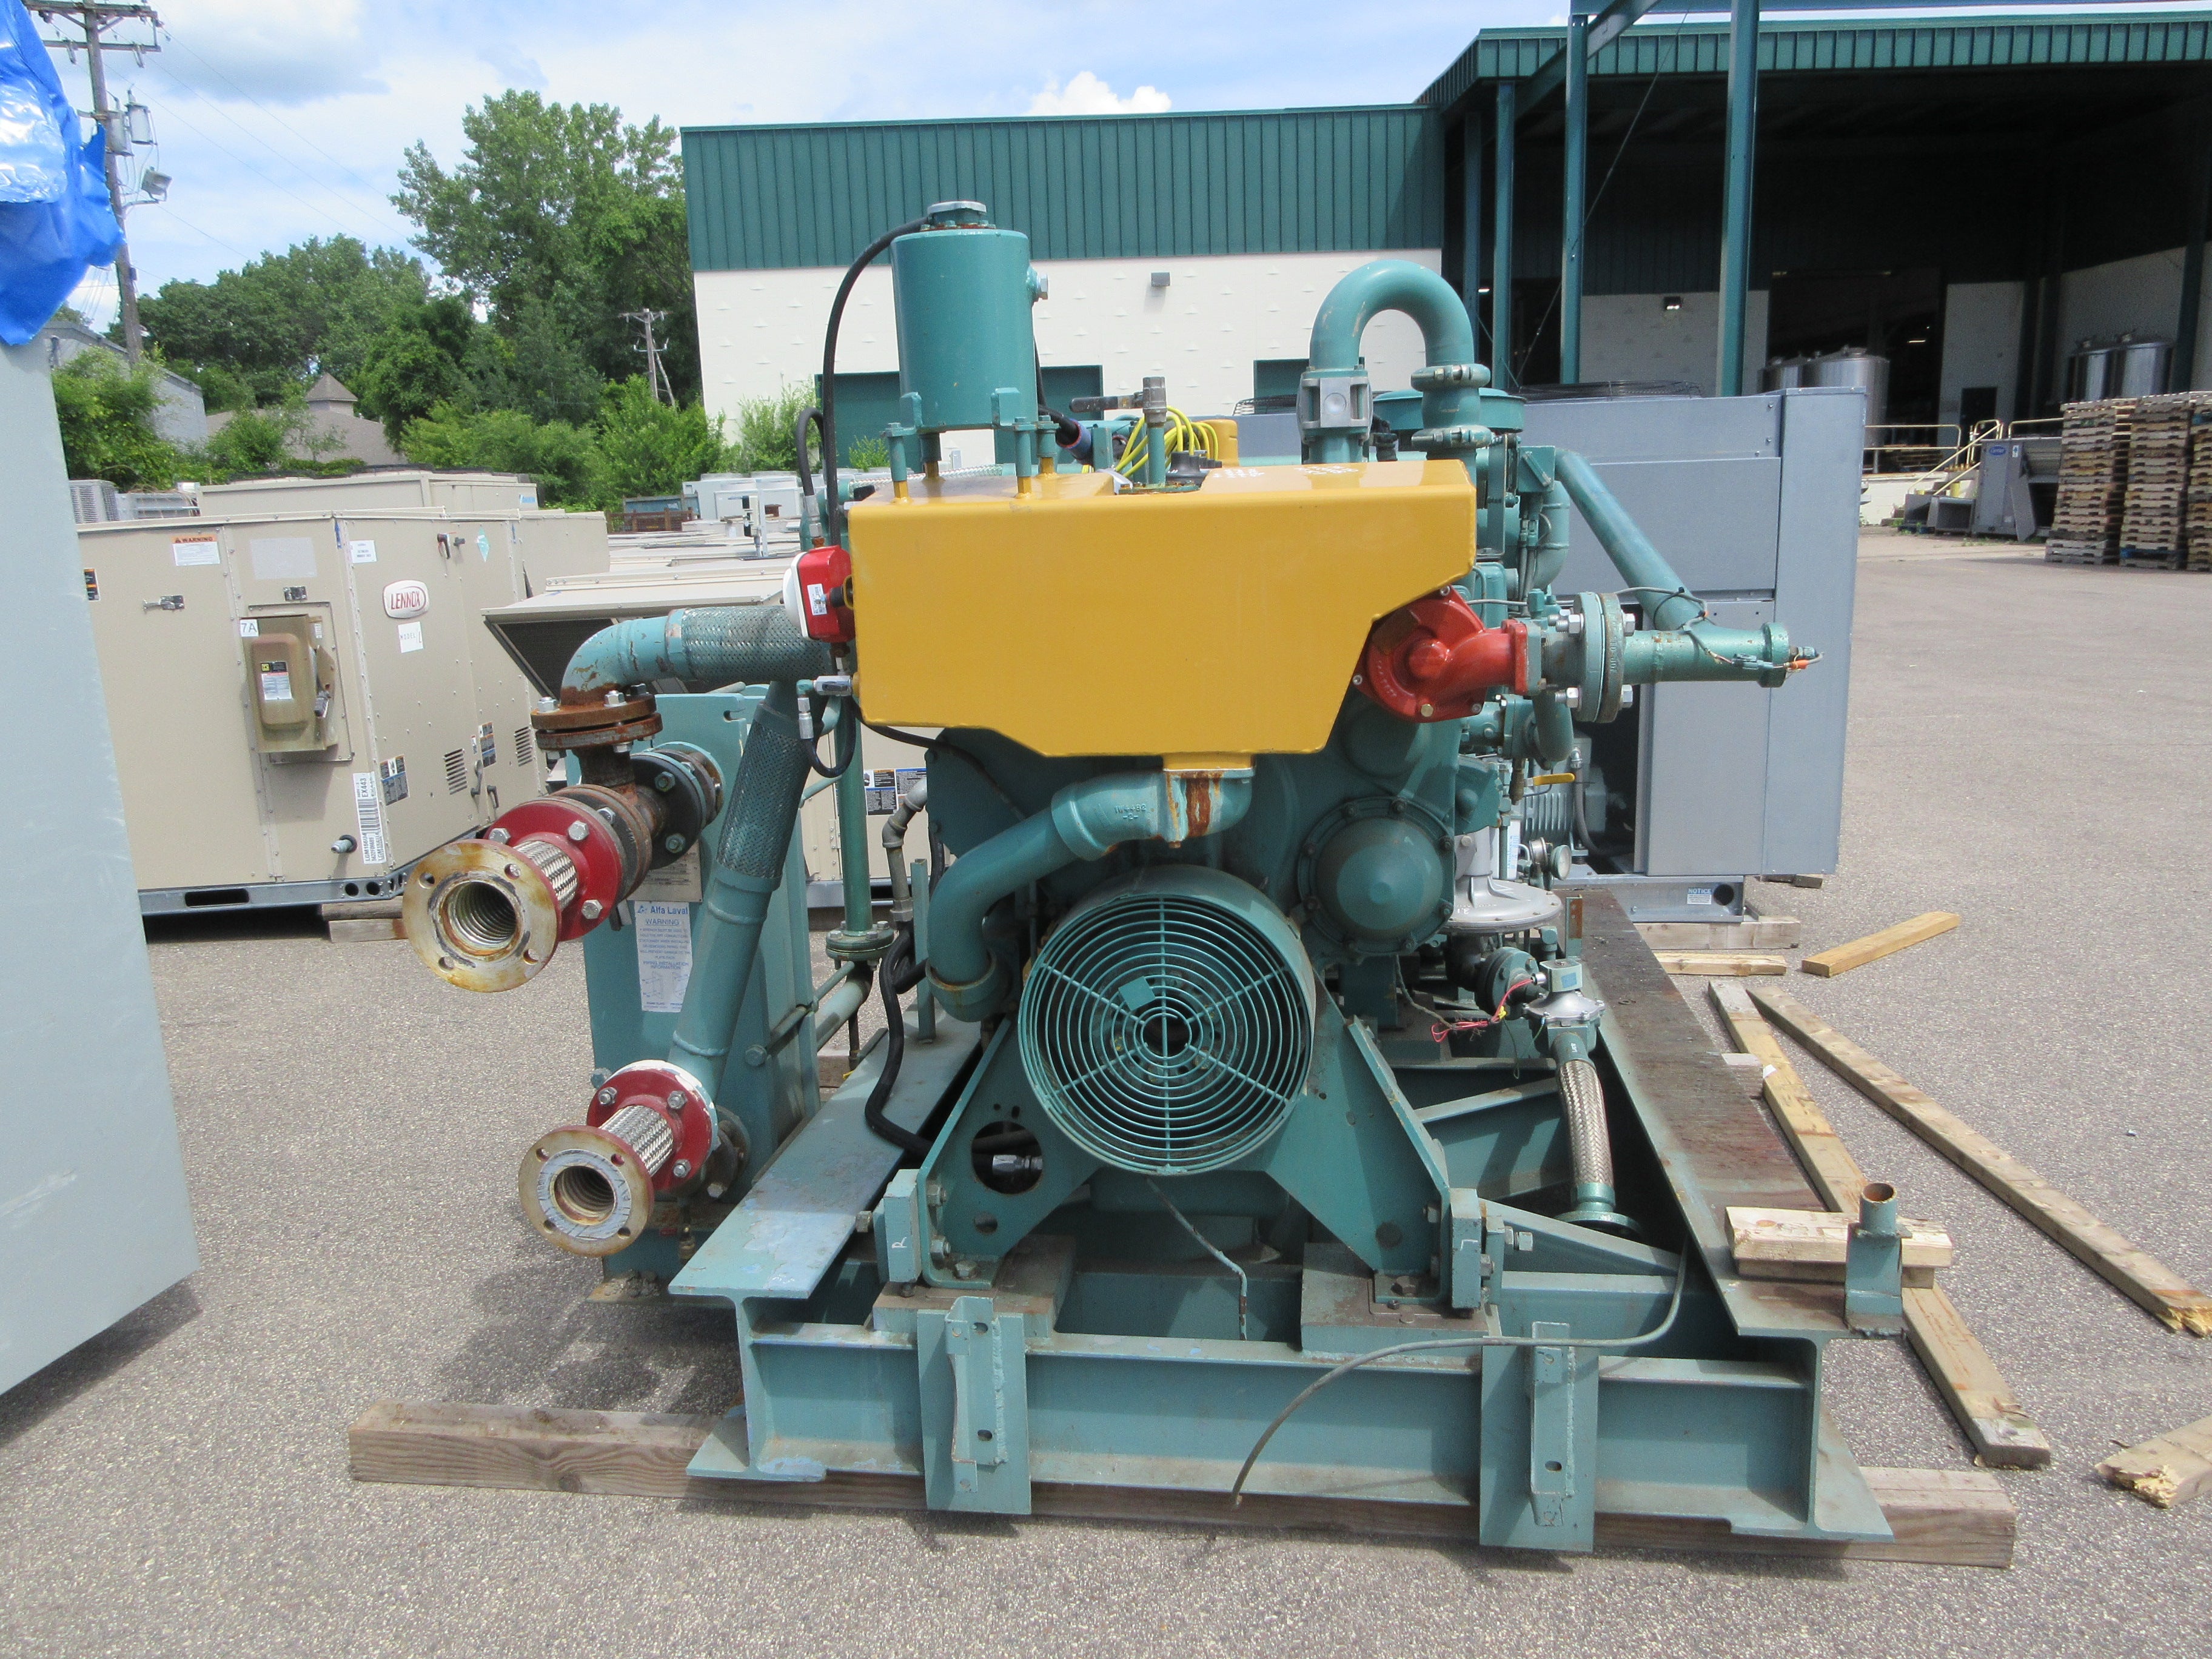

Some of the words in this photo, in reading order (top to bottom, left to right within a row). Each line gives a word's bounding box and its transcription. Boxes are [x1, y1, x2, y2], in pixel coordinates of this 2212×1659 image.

[391, 591, 420, 609] LENNOX
[241, 623, 257, 632] 7A
[360, 778, 369, 797] EX443
